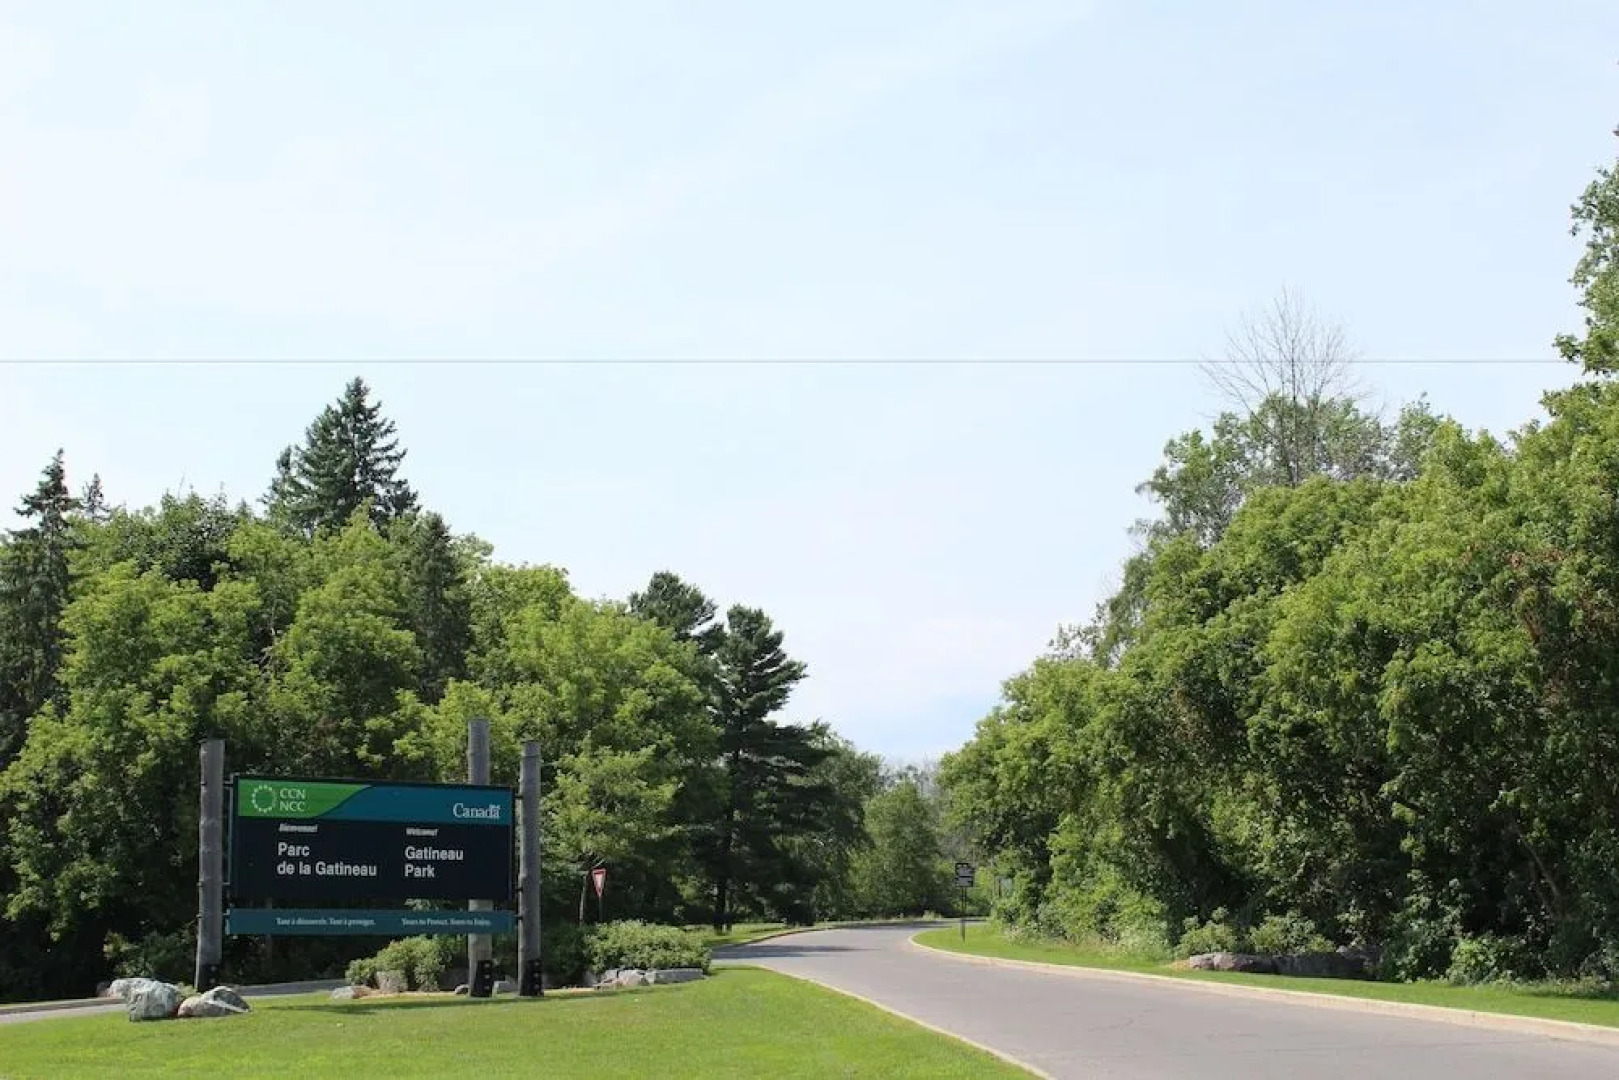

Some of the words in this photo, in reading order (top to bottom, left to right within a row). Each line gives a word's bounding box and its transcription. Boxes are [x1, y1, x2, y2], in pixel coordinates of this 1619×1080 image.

[279, 788, 306, 799] CCN
[279, 801, 306, 812] NCC
[452, 803, 500, 819] Canada
[278, 842, 310, 856] Parc
[405, 846, 464, 861] Gatineau
[277, 861, 295, 875] de
[299, 861, 311, 875] la
[315, 861, 377, 876] Gatineau
[405, 863, 435, 878] Park
